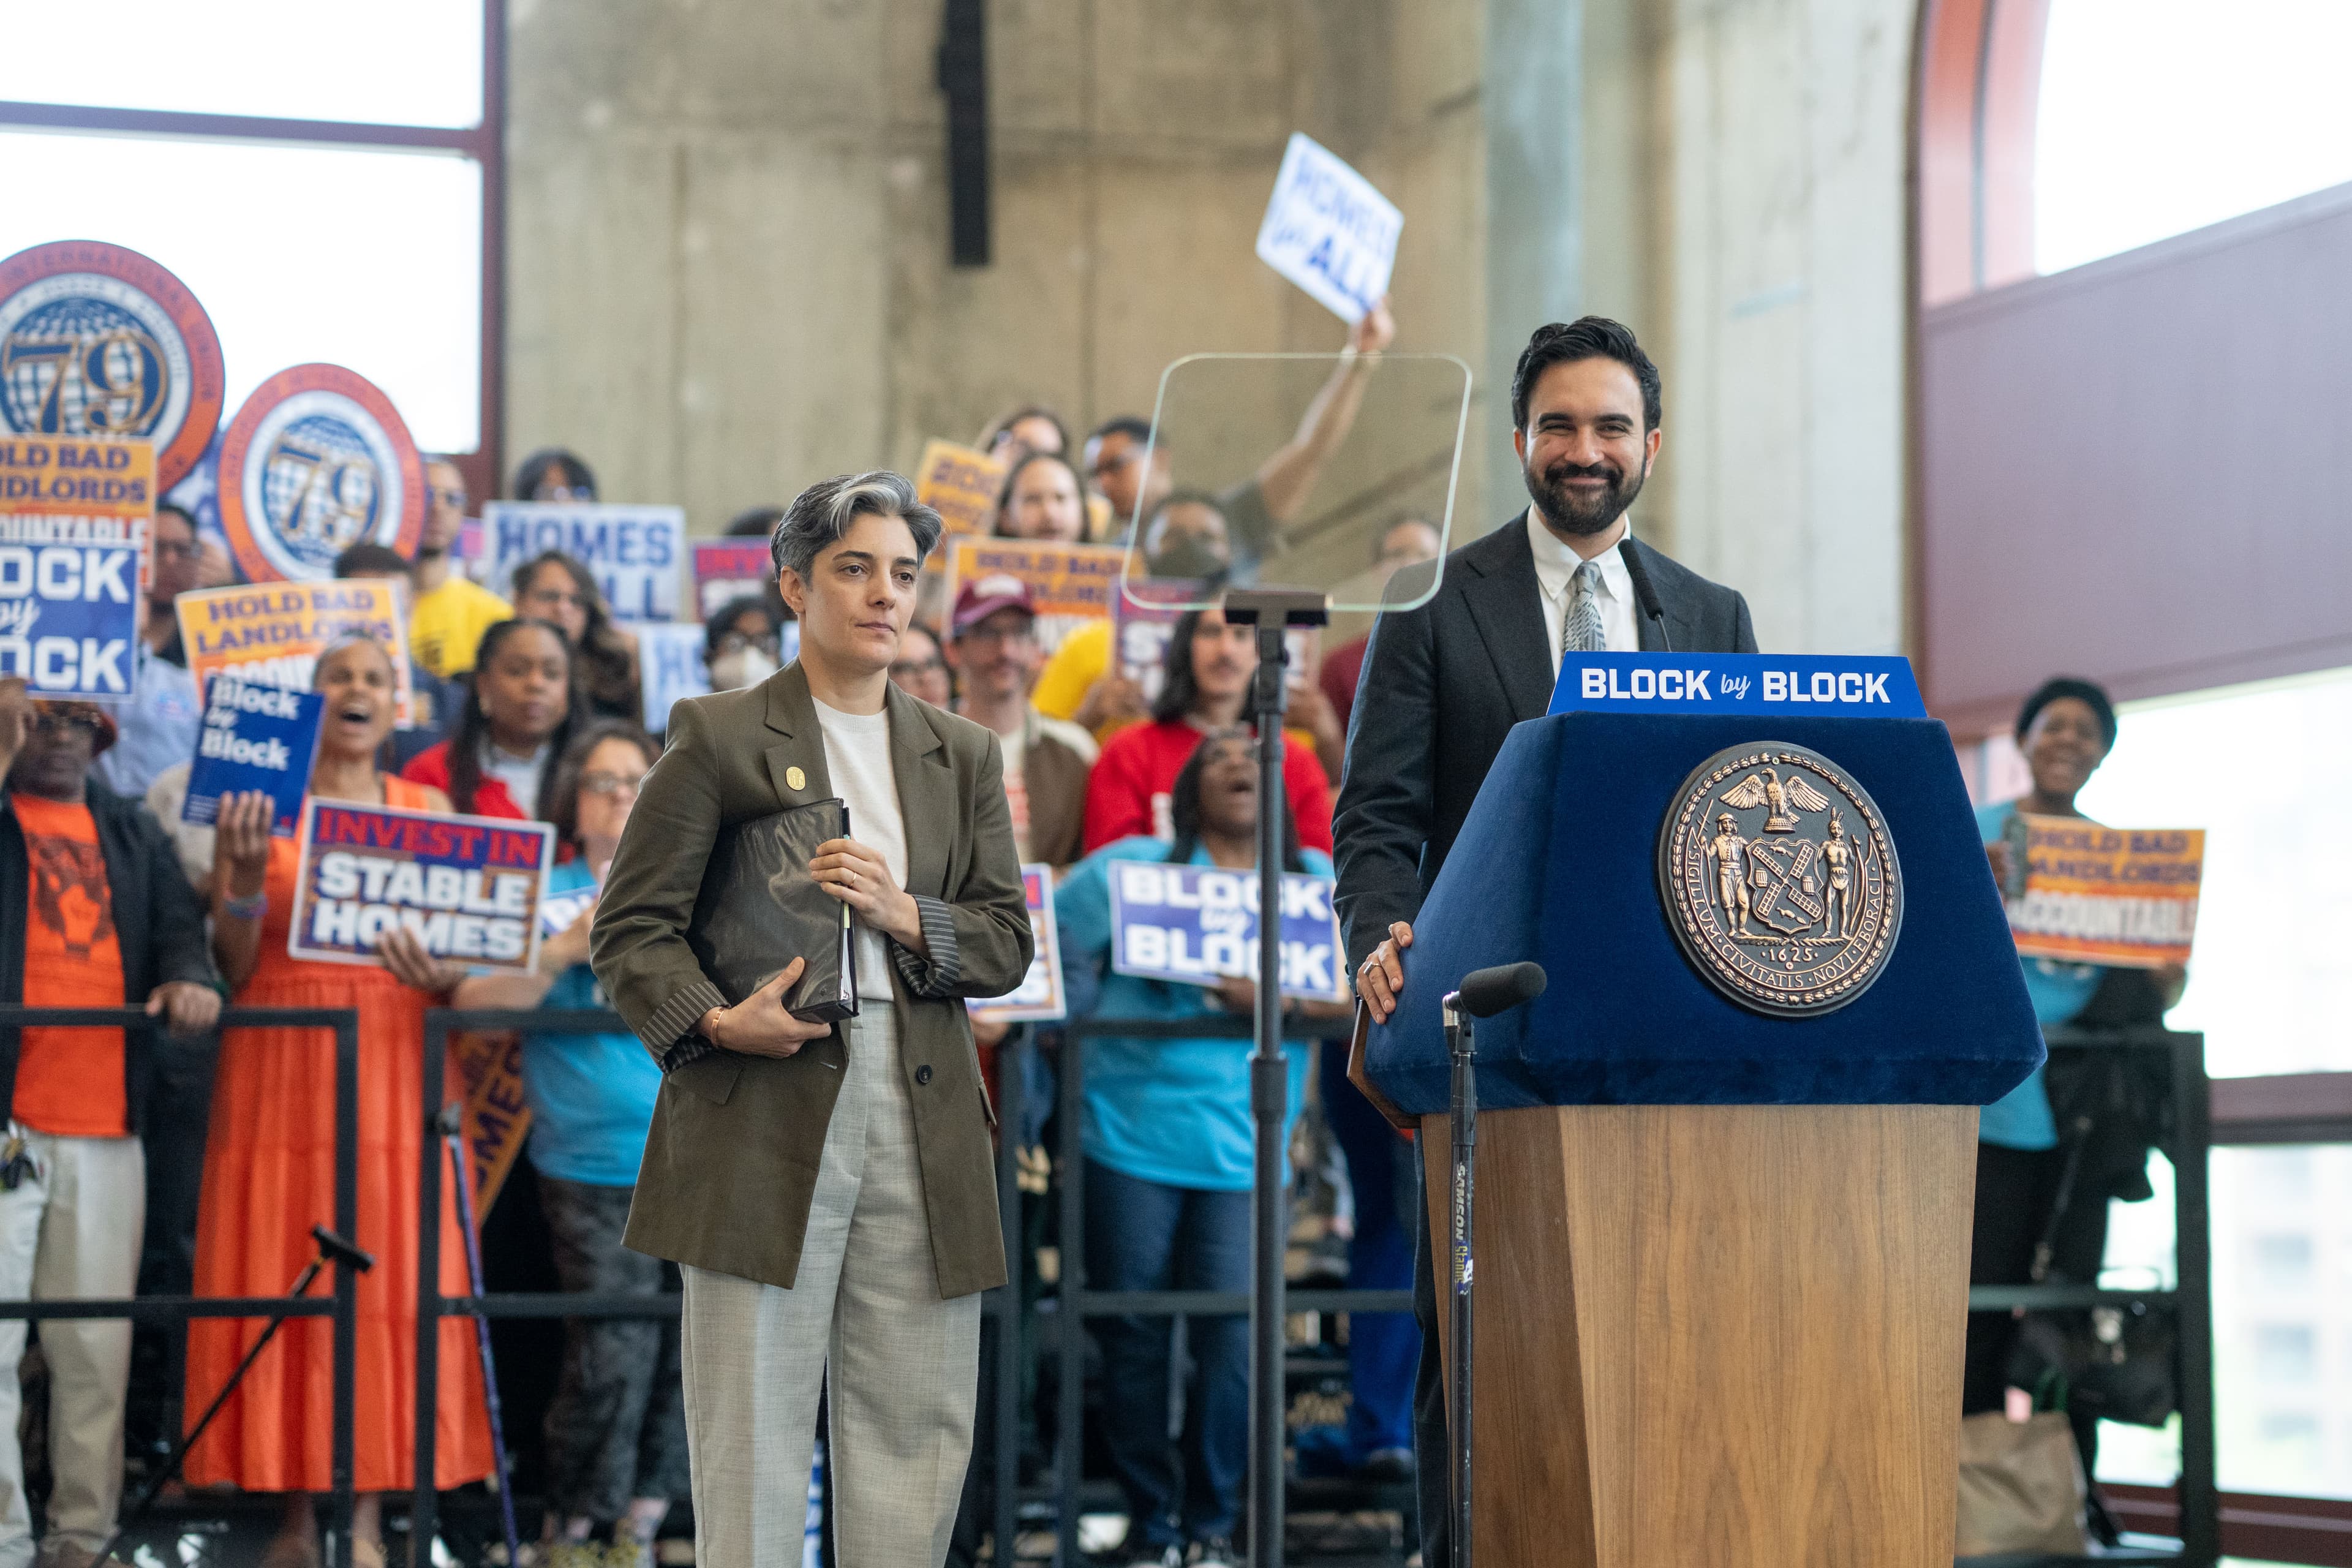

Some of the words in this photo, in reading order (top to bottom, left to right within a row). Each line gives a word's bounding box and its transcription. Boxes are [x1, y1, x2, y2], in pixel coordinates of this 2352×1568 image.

[2, 334, 168, 432] 79
[59, 445, 131, 472] BAD
[268, 437, 383, 548] 79
[496, 514, 673, 567] HOMES
[208, 592, 304, 624] HOLD
[311, 589, 375, 611] BAD
[211, 676, 300, 721] Block
[1581, 668, 1713, 701] BLOCK
[1721, 673, 1751, 700] by
[1762, 671, 1891, 704] BLOCK
[200, 726, 290, 772] Block
[318, 808, 484, 861] INVEST
[488, 830, 541, 865] IN
[318, 851, 531, 918] STABLE
[312, 897, 527, 960] HOMES
[1687, 850, 1721, 940] SIGILLUM
[1721, 944, 1803, 988] CIVITATIS
[1813, 951, 1856, 985] NOVI
[1853, 876, 1881, 954] EBORACI
[1768, 947, 1813, 962] 1625
[1455, 1164, 1466, 1241] SAMSON
